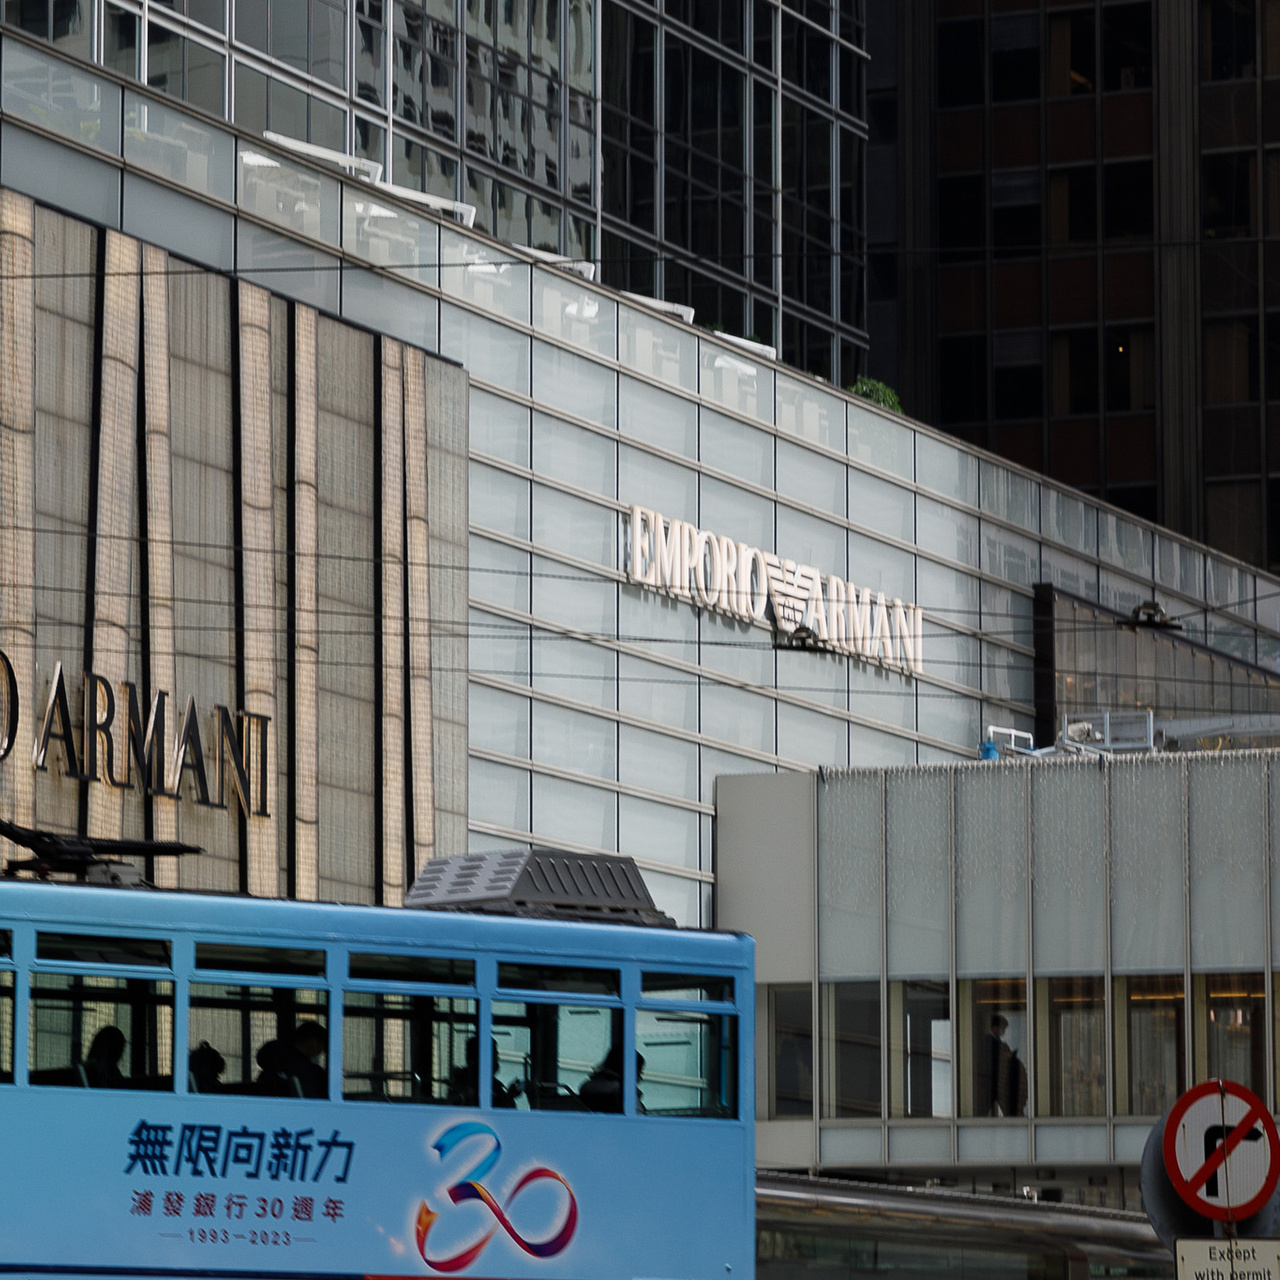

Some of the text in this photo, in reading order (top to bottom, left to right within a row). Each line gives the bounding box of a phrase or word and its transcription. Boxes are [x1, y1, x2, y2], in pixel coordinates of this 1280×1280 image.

[631, 505, 923, 673] EMPORIO ARMANI
[33, 660, 271, 819] ARMANI
[124, 1118, 355, 1184] 無限向新力
[1209, 1246, 1257, 1263] Except
